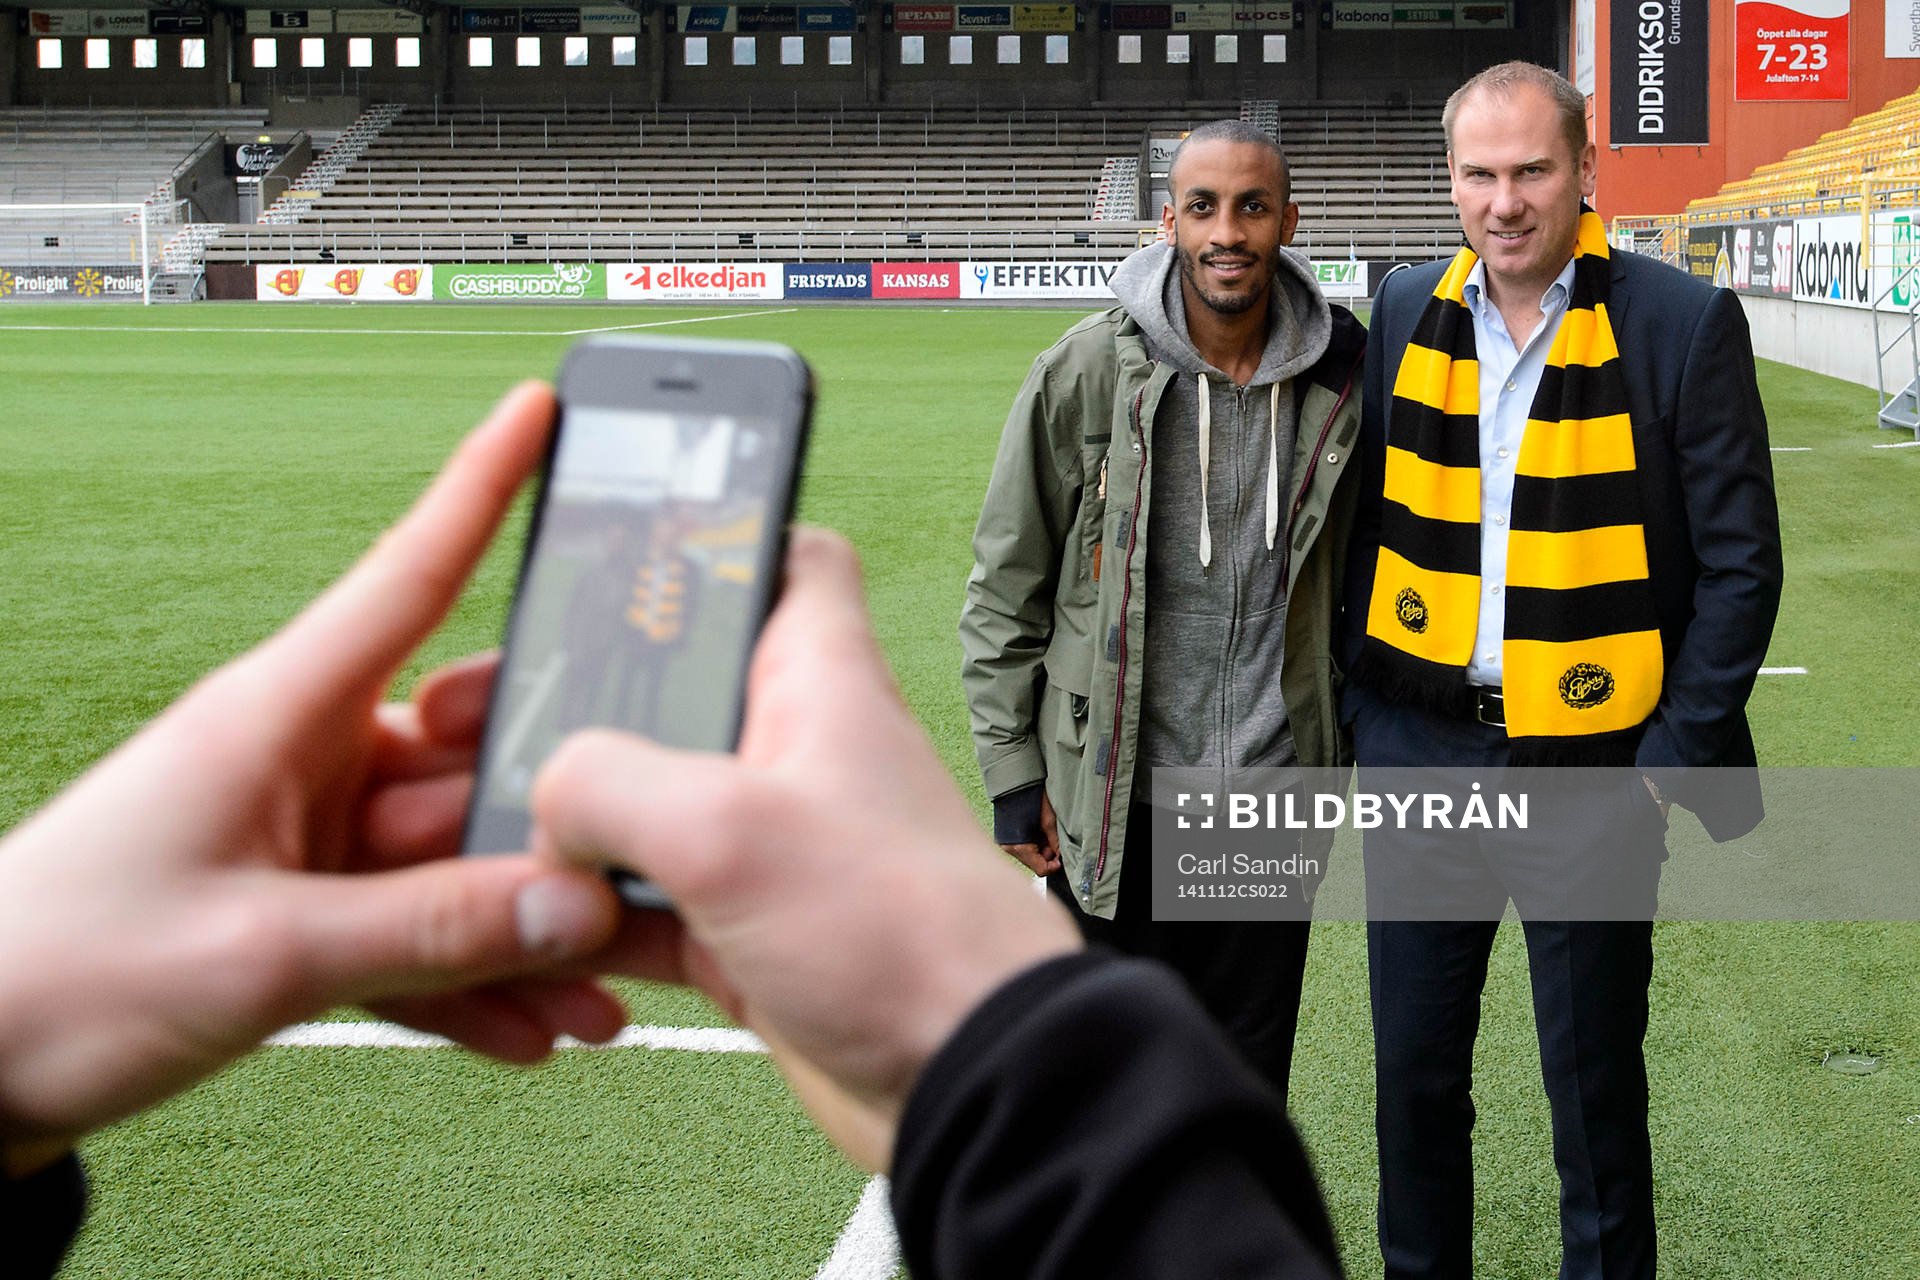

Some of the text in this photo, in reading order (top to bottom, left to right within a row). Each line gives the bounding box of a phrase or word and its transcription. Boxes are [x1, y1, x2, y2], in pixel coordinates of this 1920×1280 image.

[471, 15, 499, 26] Make
[504, 15, 516, 26] IT
[693, 18, 720, 26] KPMG
[905, 11, 945, 20] PEAB
[1336, 9, 1390, 22] kabona
[1757, 27, 1828, 40] Öppet alla dagar
[1757, 43, 1828, 70] 7-23
[1638, 1, 1664, 134] DIDRIKSO
[1765, 73, 1820, 83] Julafton 7-14
[1796, 222, 1868, 303] kabona
[657, 266, 766, 292] elkedjan
[789, 273, 867, 288] FRISTADS
[882, 273, 950, 288] KANSAS
[994, 265, 1118, 287] EFFEKTIV
[15, 276, 69, 293] Prolight
[104, 276, 144, 293] Prolig
[454, 279, 580, 295] CASHBUDDY.se
